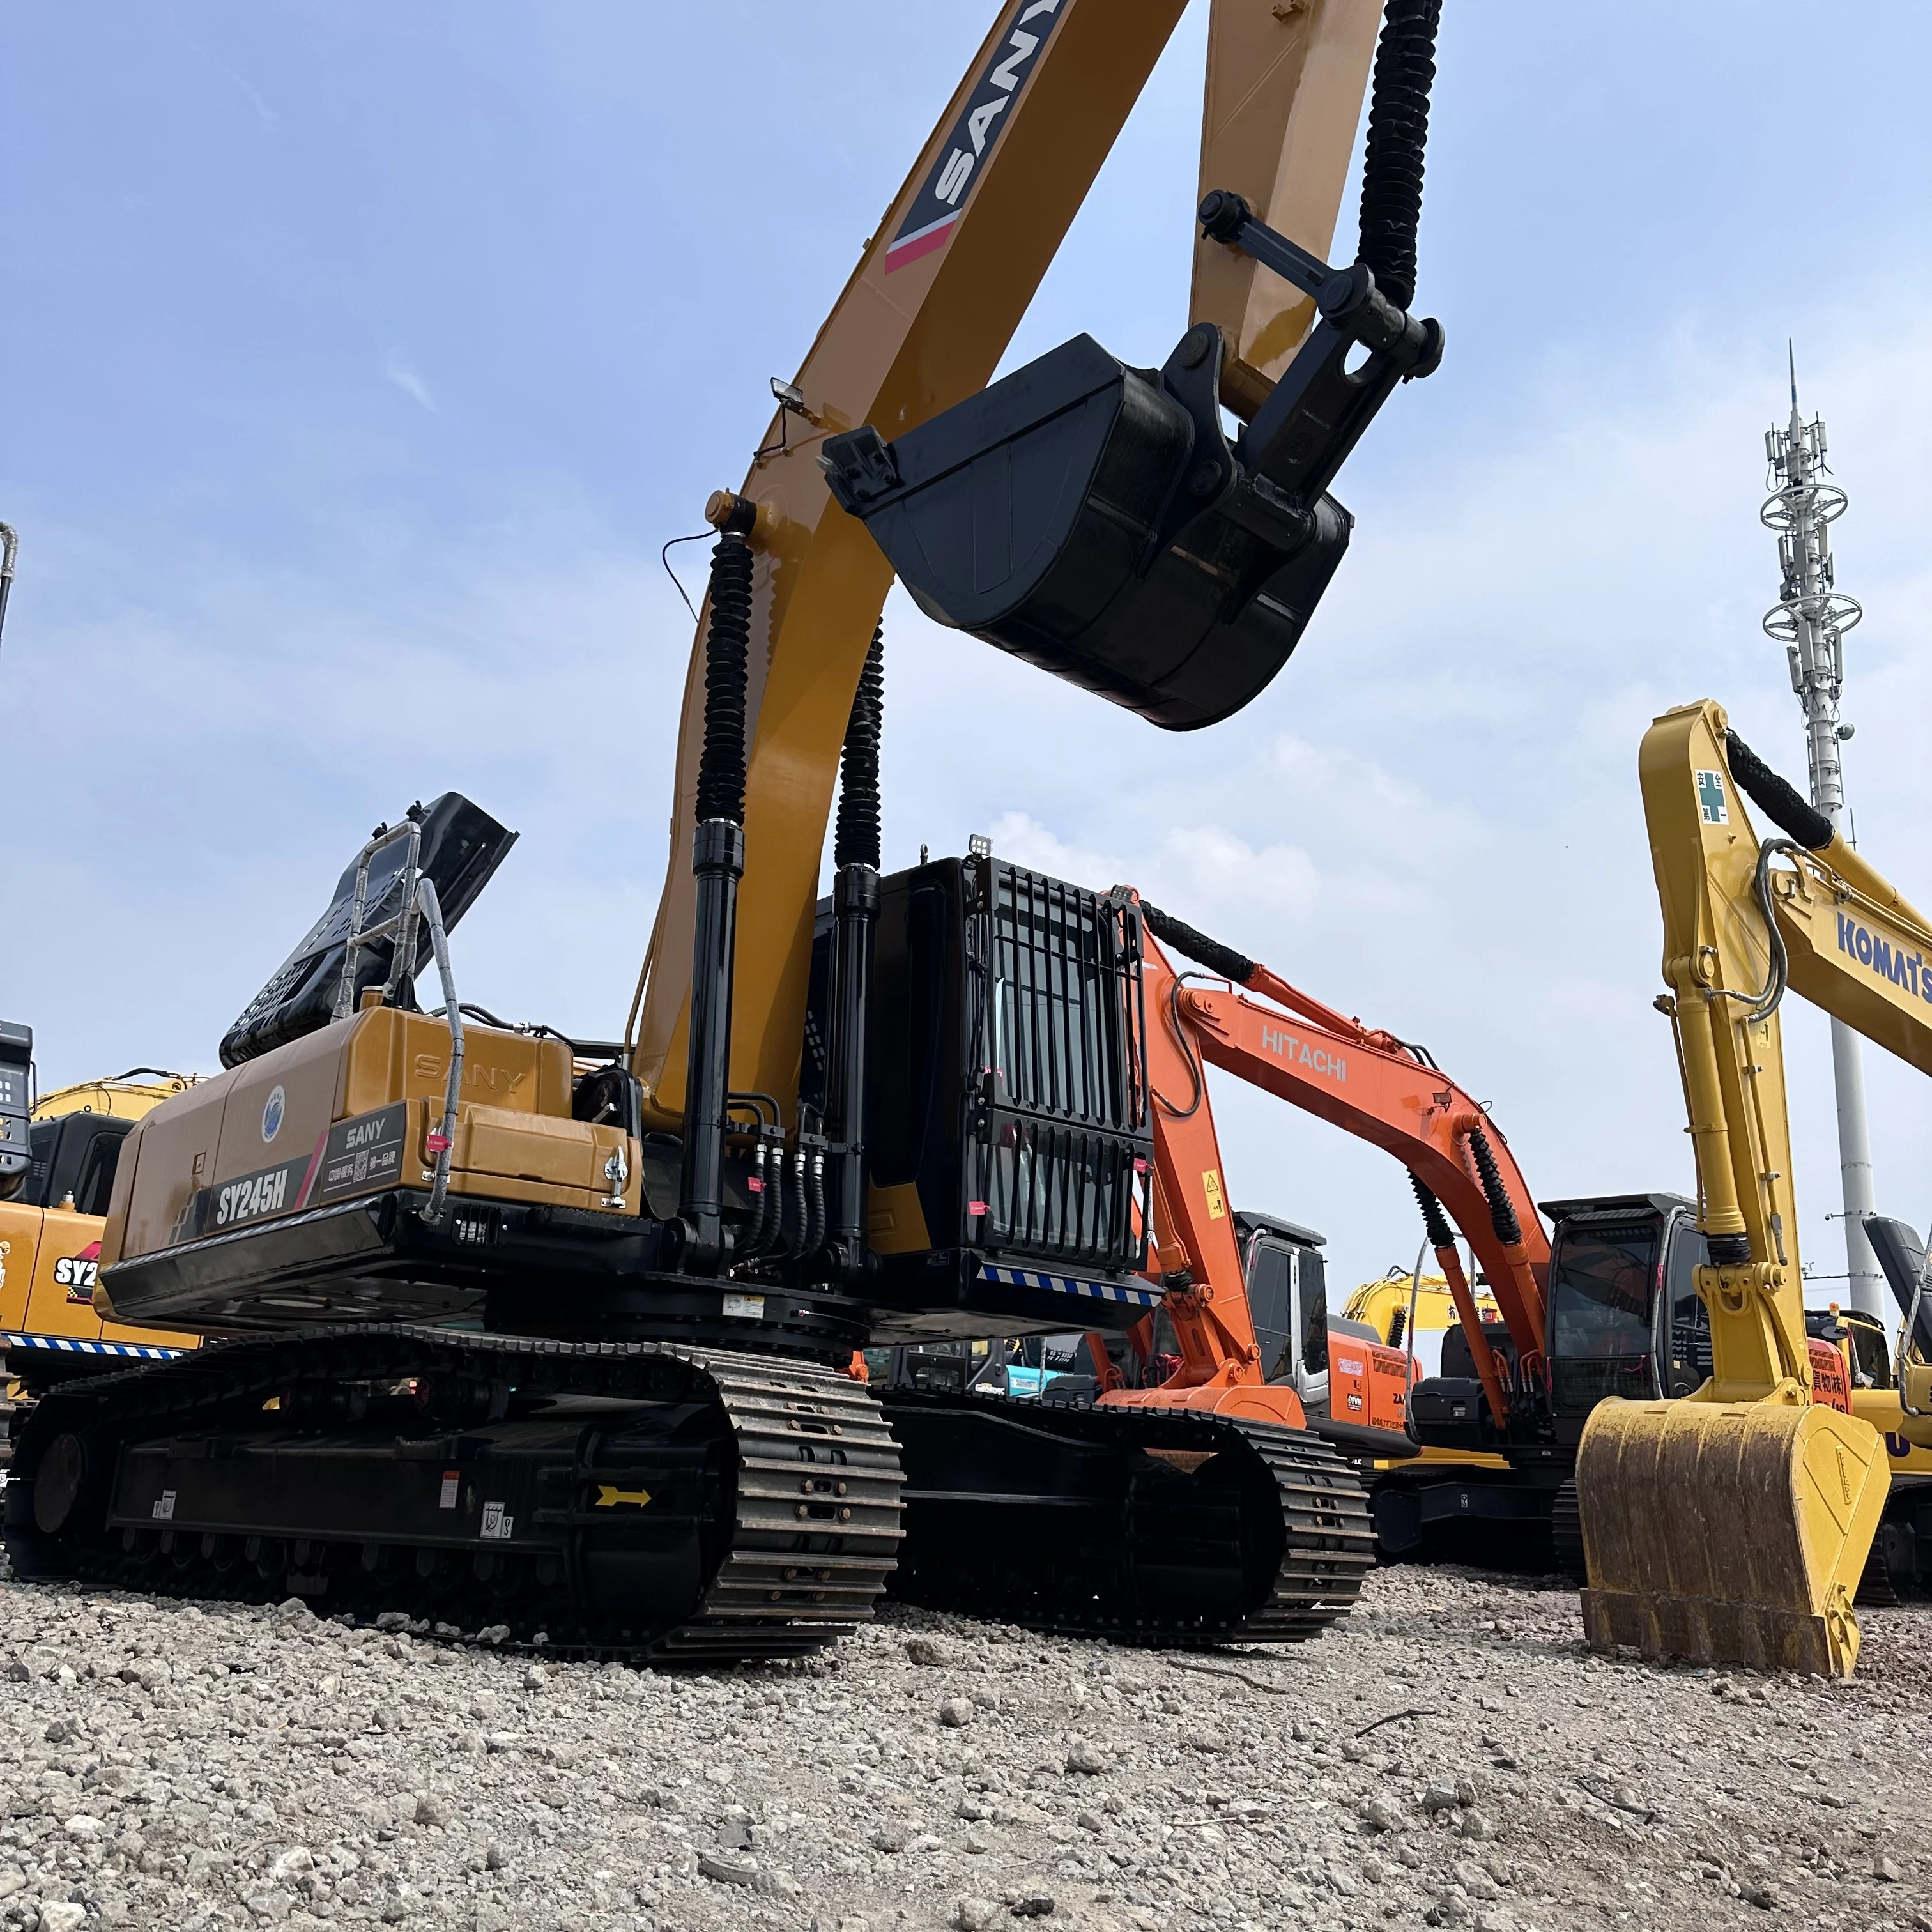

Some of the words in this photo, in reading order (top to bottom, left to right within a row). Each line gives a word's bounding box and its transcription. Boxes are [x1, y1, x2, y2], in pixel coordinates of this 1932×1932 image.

[1837, 911, 1932, 1004] KOMATS
[1262, 1025, 1346, 1082] HITACHI
[346, 1117, 386, 1149] SANY
[217, 1169, 288, 1225] SY245H
